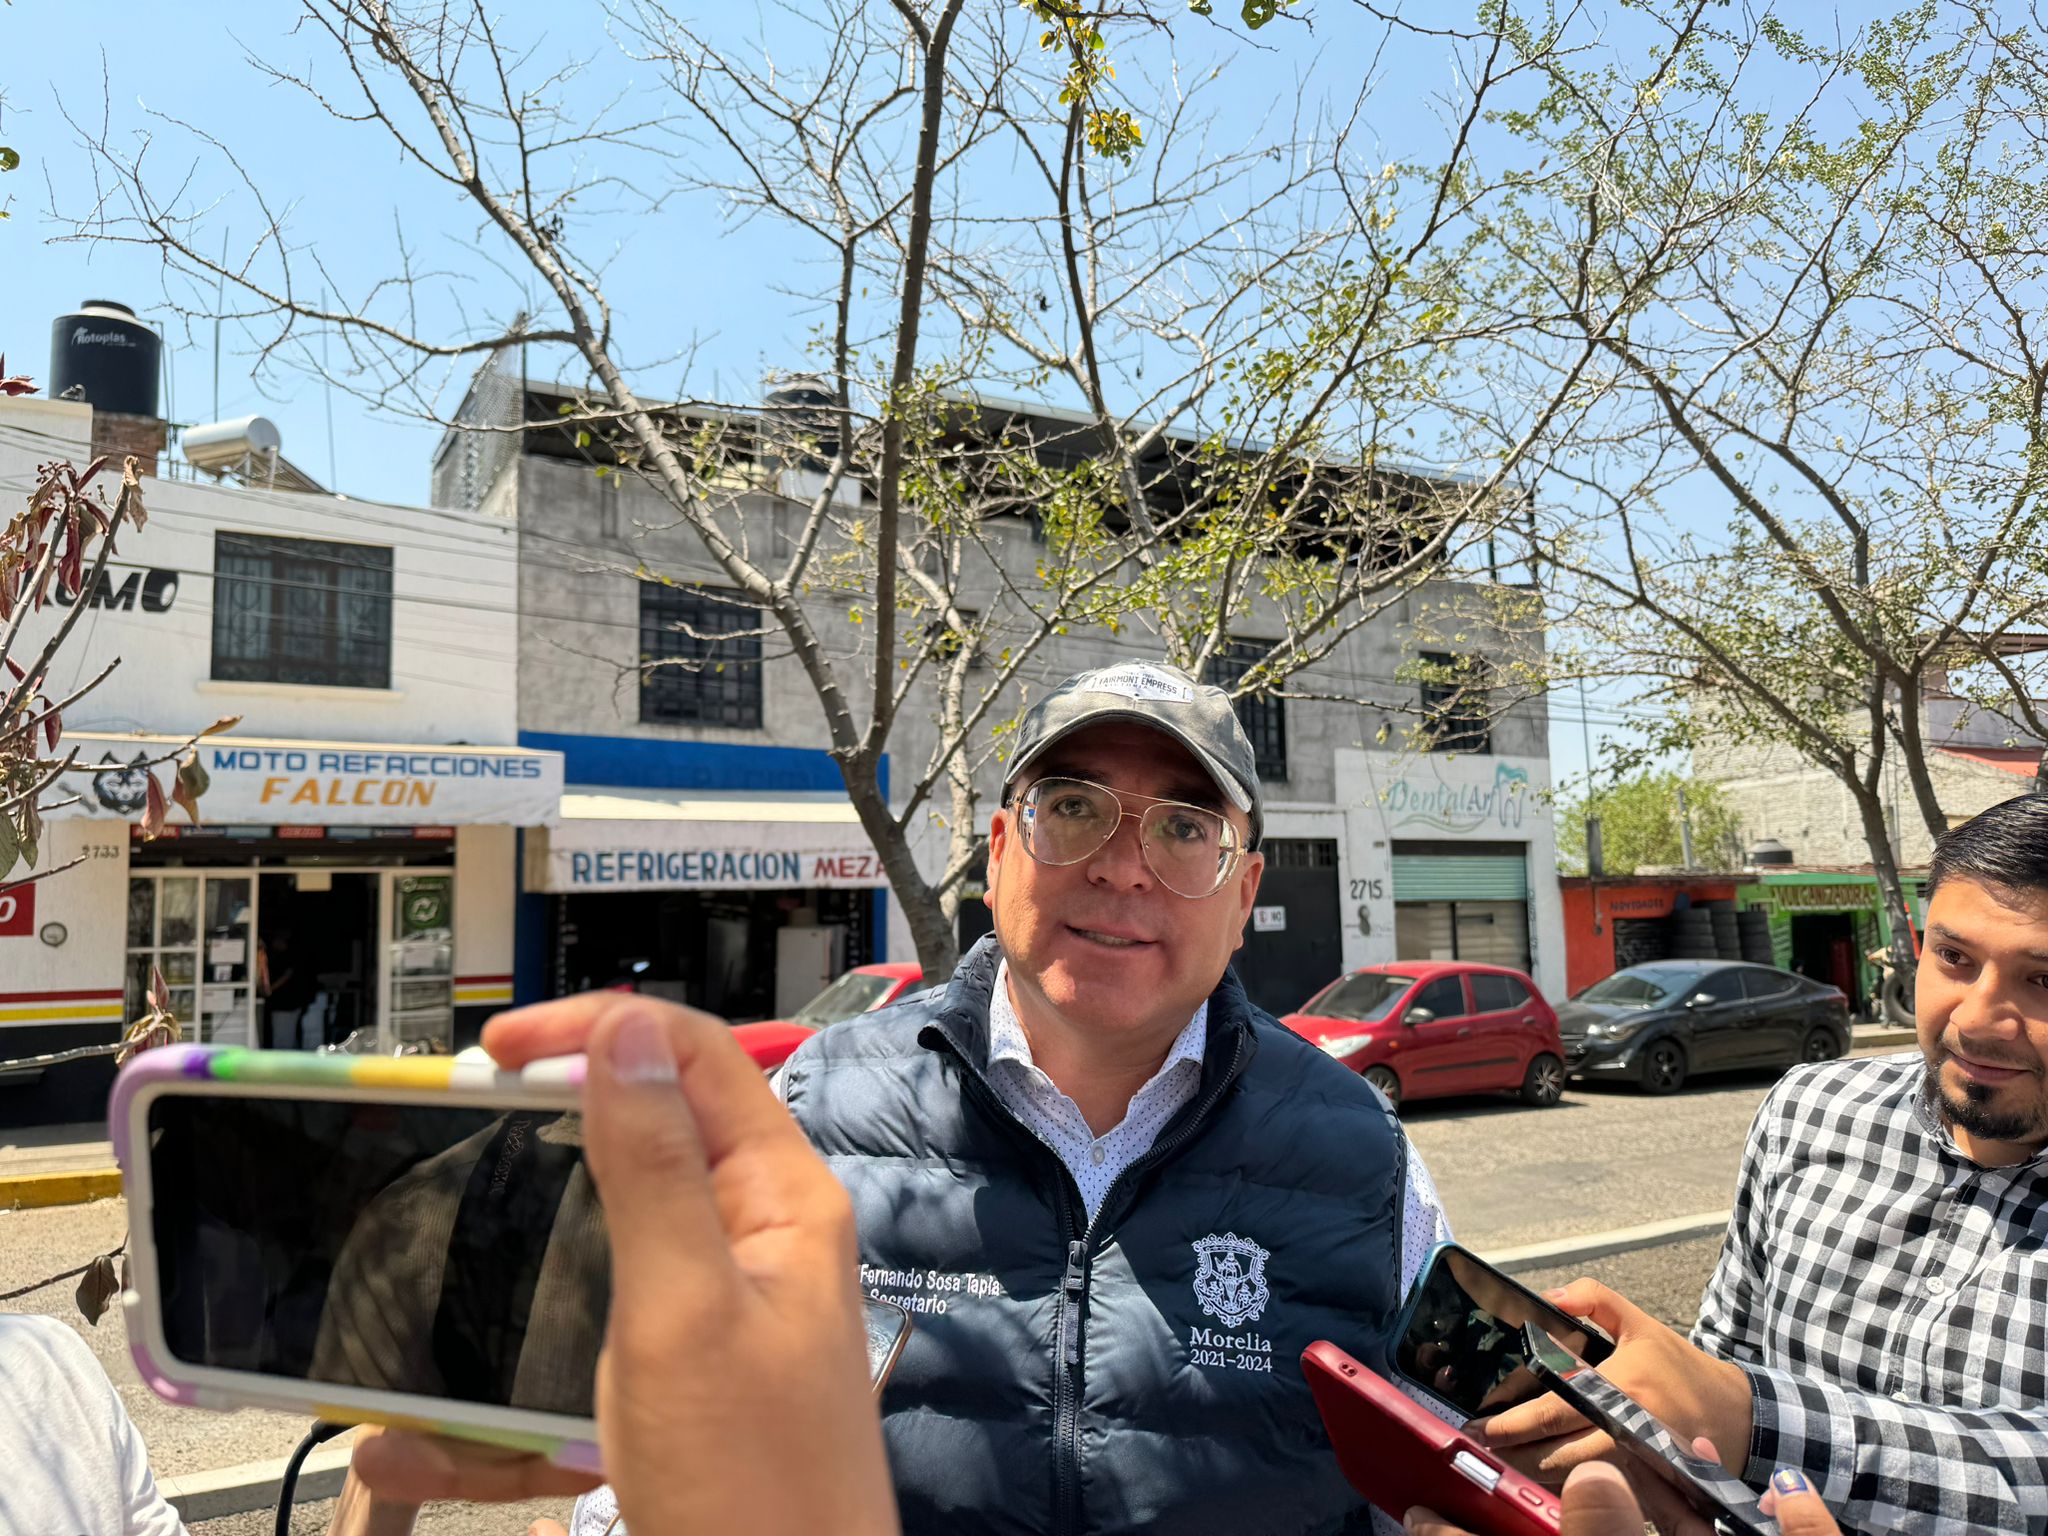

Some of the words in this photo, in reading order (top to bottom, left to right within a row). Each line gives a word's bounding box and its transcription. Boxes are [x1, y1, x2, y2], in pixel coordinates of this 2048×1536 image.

[1099, 675, 1138, 685] FAIRMONT
[1141, 677, 1177, 694] EMPRESS
[213, 751, 307, 772] MOTO
[319, 754, 541, 779] REFACCIONES
[571, 851, 801, 883] REFRIGERACION
[1349, 880, 1383, 900] 2715
[860, 1263, 923, 1289] Fernando
[926, 1270, 961, 1293] Sosa
[965, 1273, 1001, 1298] Tapia
[1189, 1326, 1272, 1352] Morelia
[1190, 1348, 1273, 1373] 2021-2024
